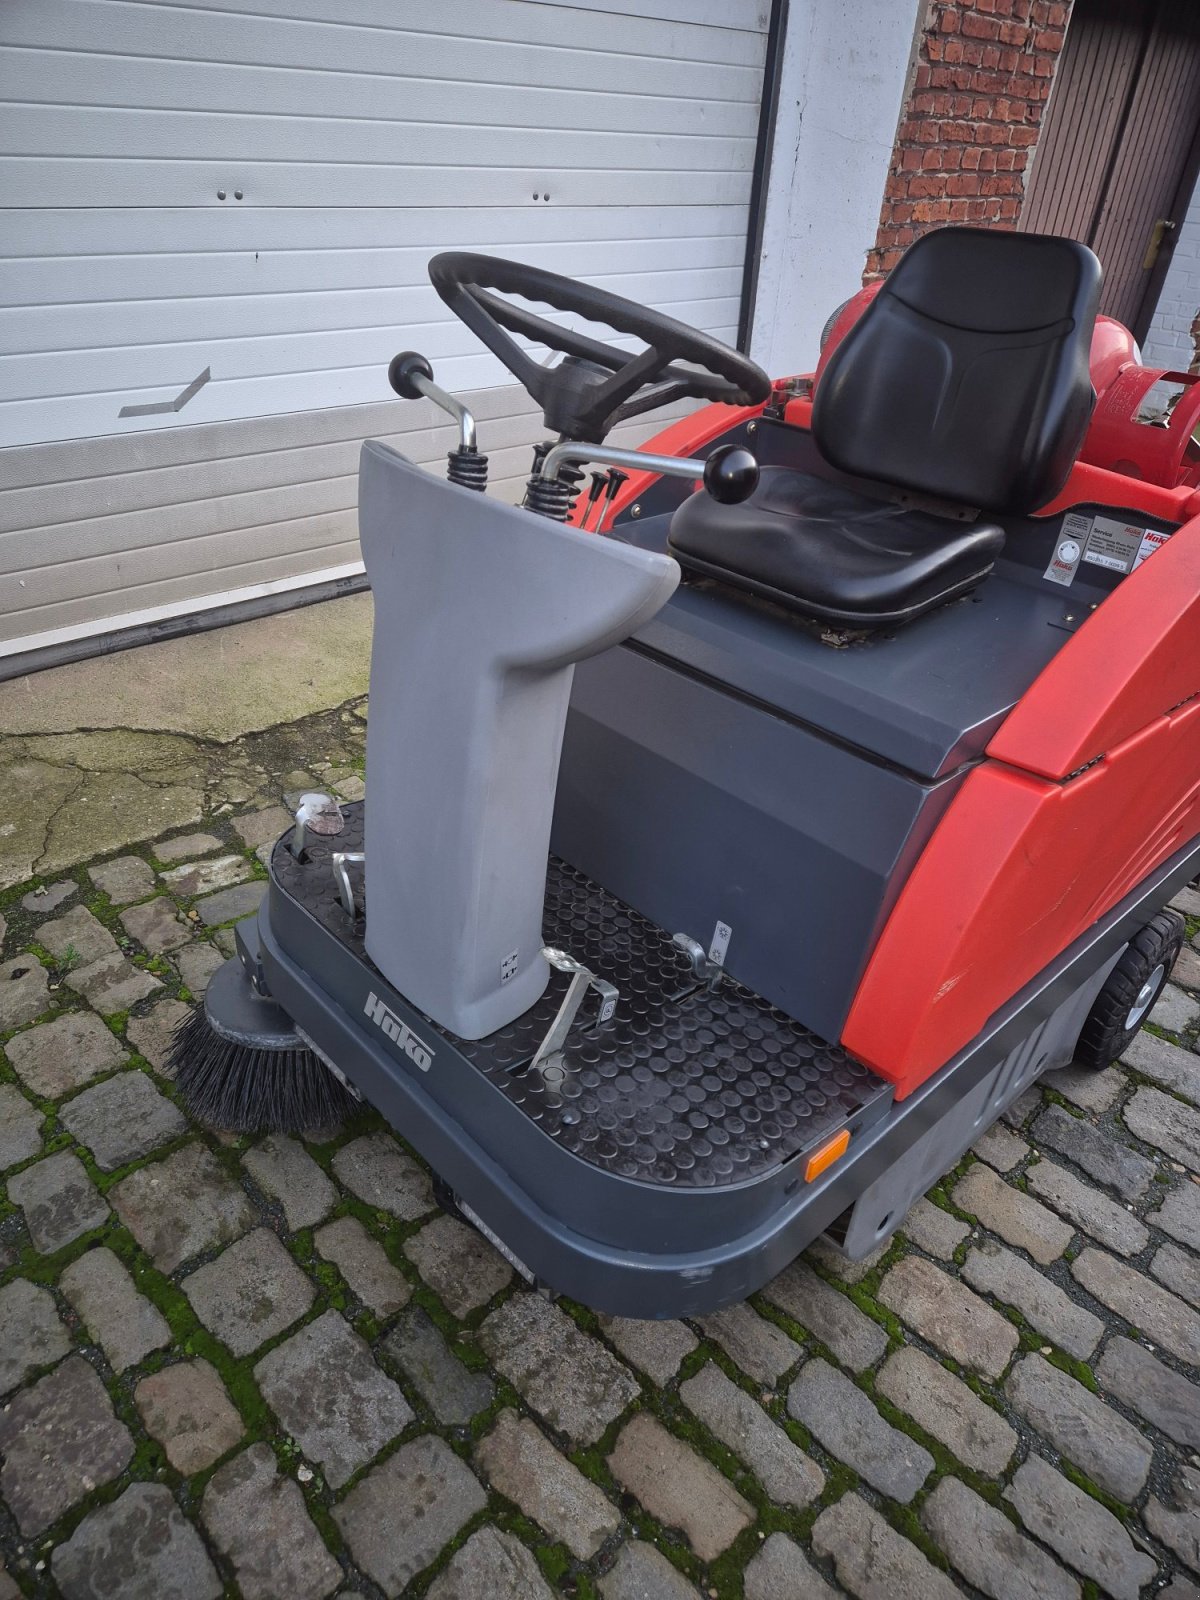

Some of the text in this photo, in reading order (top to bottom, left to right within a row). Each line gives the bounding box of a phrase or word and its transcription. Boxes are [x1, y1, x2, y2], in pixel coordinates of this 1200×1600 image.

[1093, 527, 1112, 538] Service
[1145, 532, 1168, 544] Hak
[363, 991, 436, 1072] Hako
